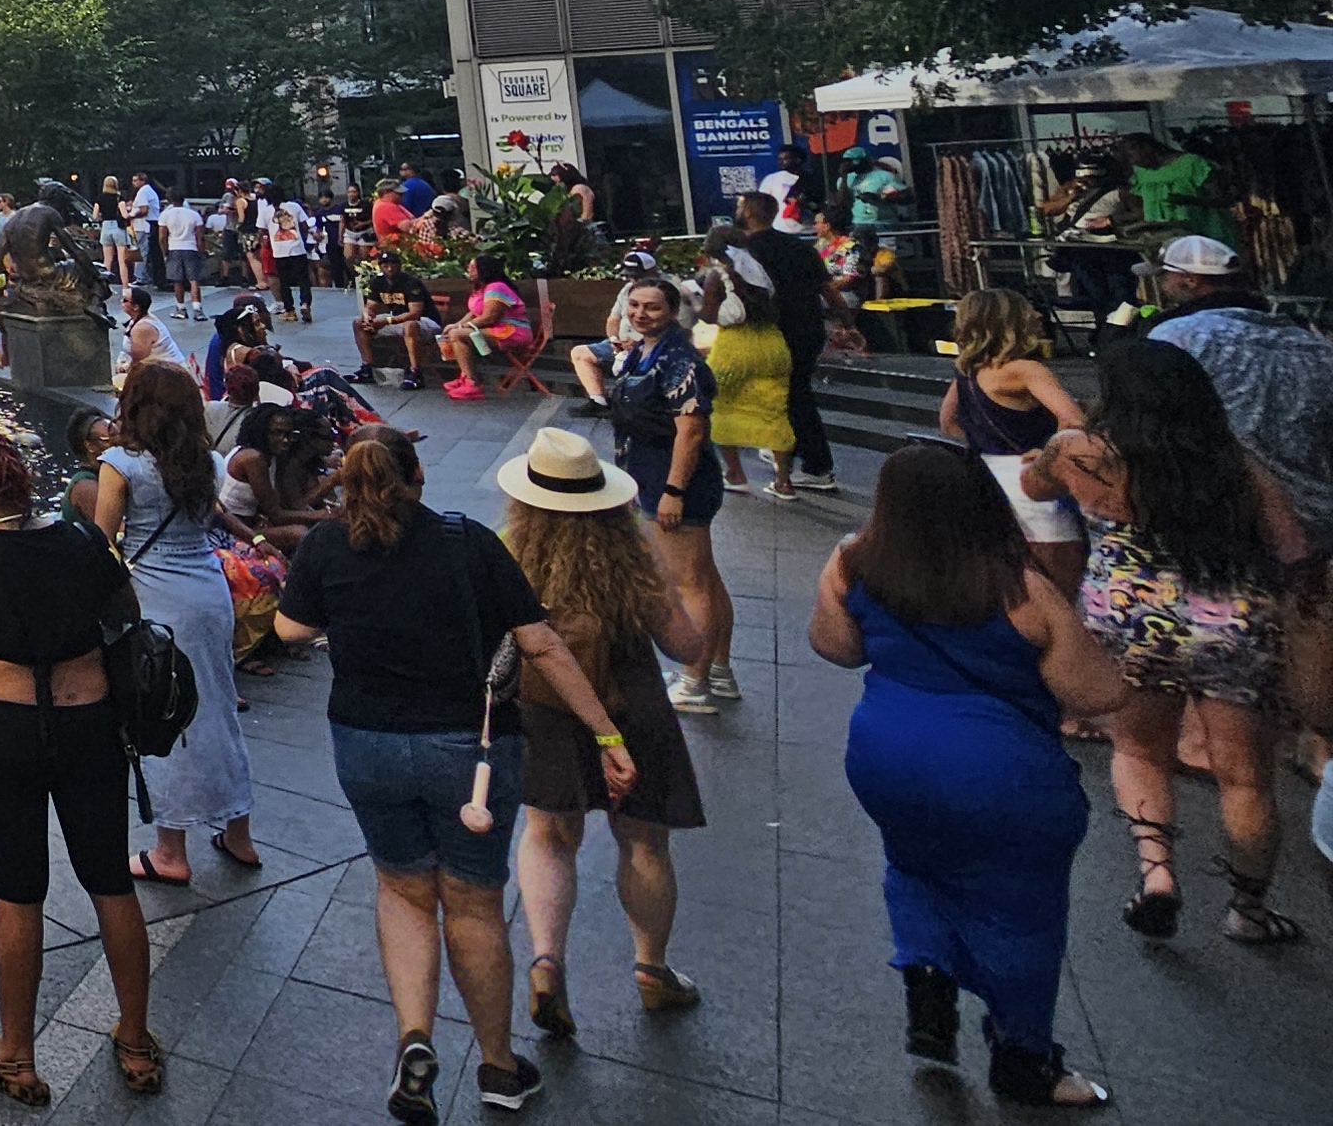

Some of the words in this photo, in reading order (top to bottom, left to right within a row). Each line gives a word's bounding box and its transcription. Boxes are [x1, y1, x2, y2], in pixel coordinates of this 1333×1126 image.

[504, 75, 545, 84] FOUNTAIN
[504, 83, 547, 97] SQUARE
[501, 112, 551, 122] Powered
[554, 113, 567, 122] by
[693, 117, 769, 130] BENGALS
[695, 130, 771, 143] BANKING
